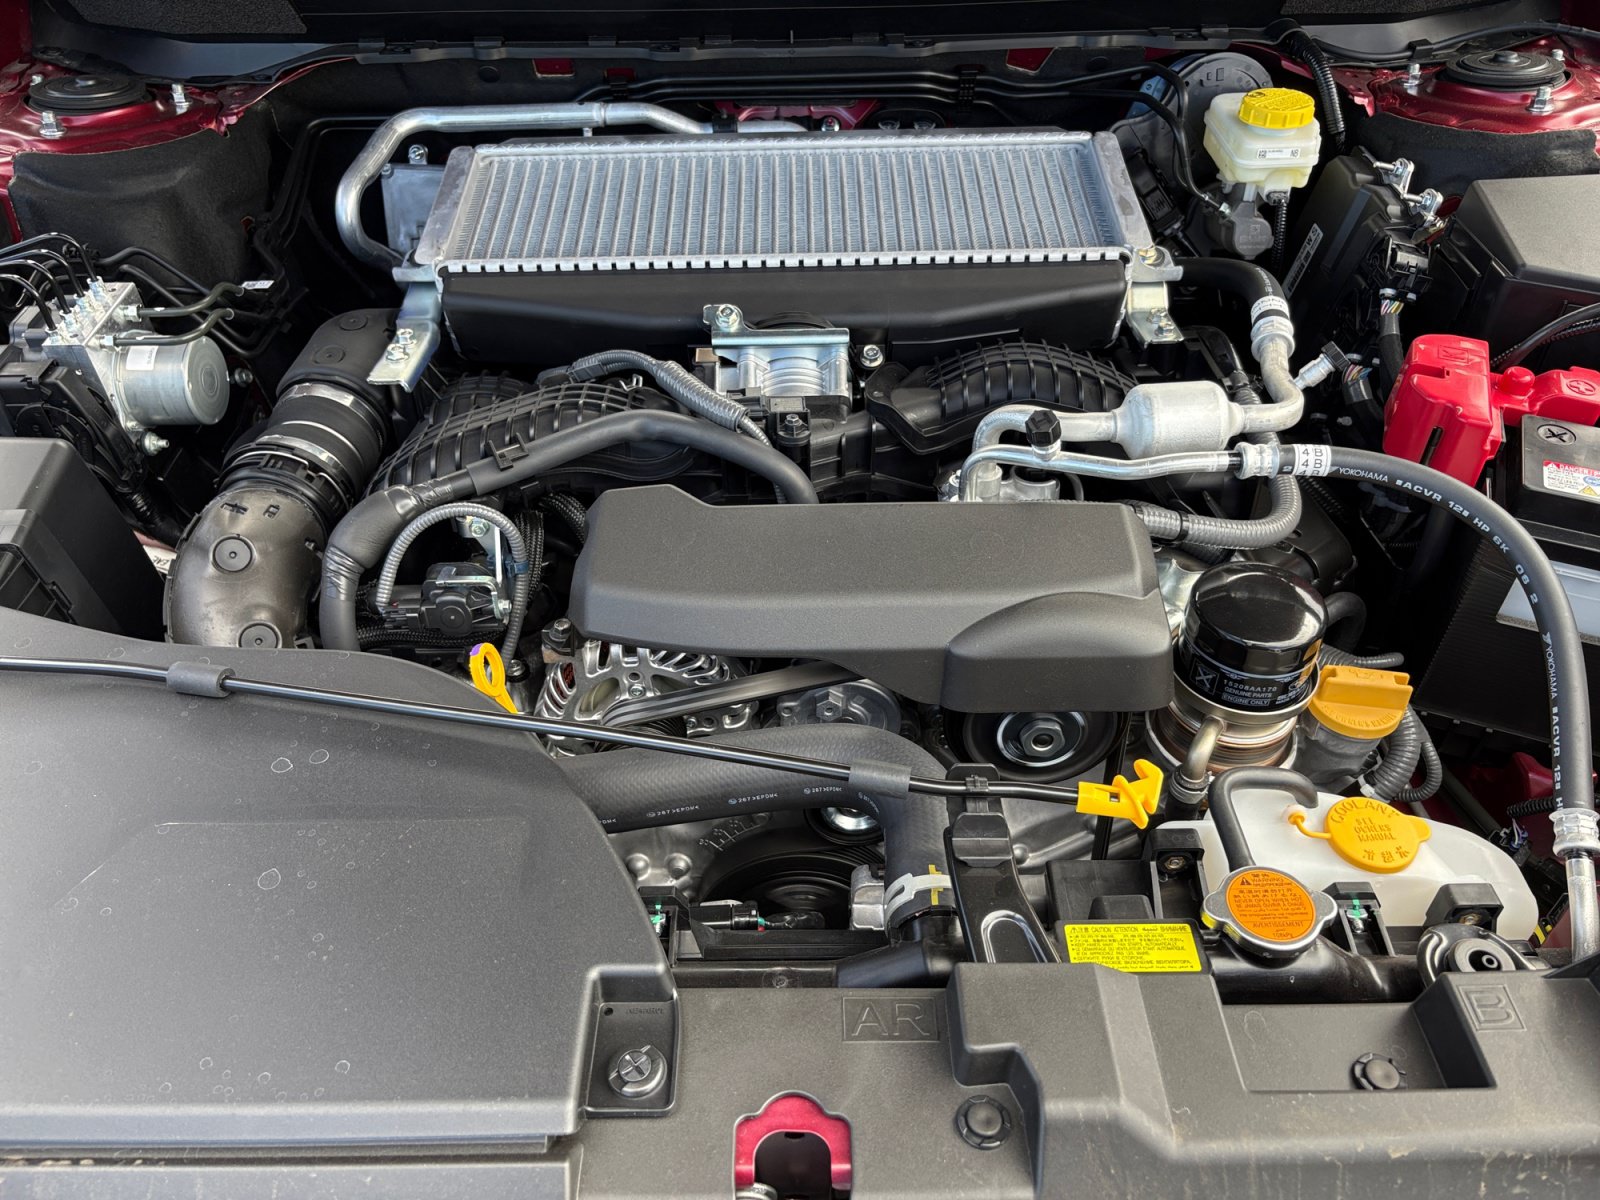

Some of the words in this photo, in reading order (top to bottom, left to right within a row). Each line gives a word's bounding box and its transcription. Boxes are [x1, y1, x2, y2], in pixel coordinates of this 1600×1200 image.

[1339, 467, 1389, 483] YOKOHAMA
[1472, 516, 1491, 533] HP
[1545, 645, 1558, 700] YOKOHAMA
[1223, 692, 1249, 704] ENGINE
[1250, 698, 1269, 706] ONLY
[1224, 687, 1251, 697] GENUINE
[1330, 800, 1400, 824] COOLANT
[850, 1002, 931, 1037] AR
[1462, 990, 1516, 1026] B
